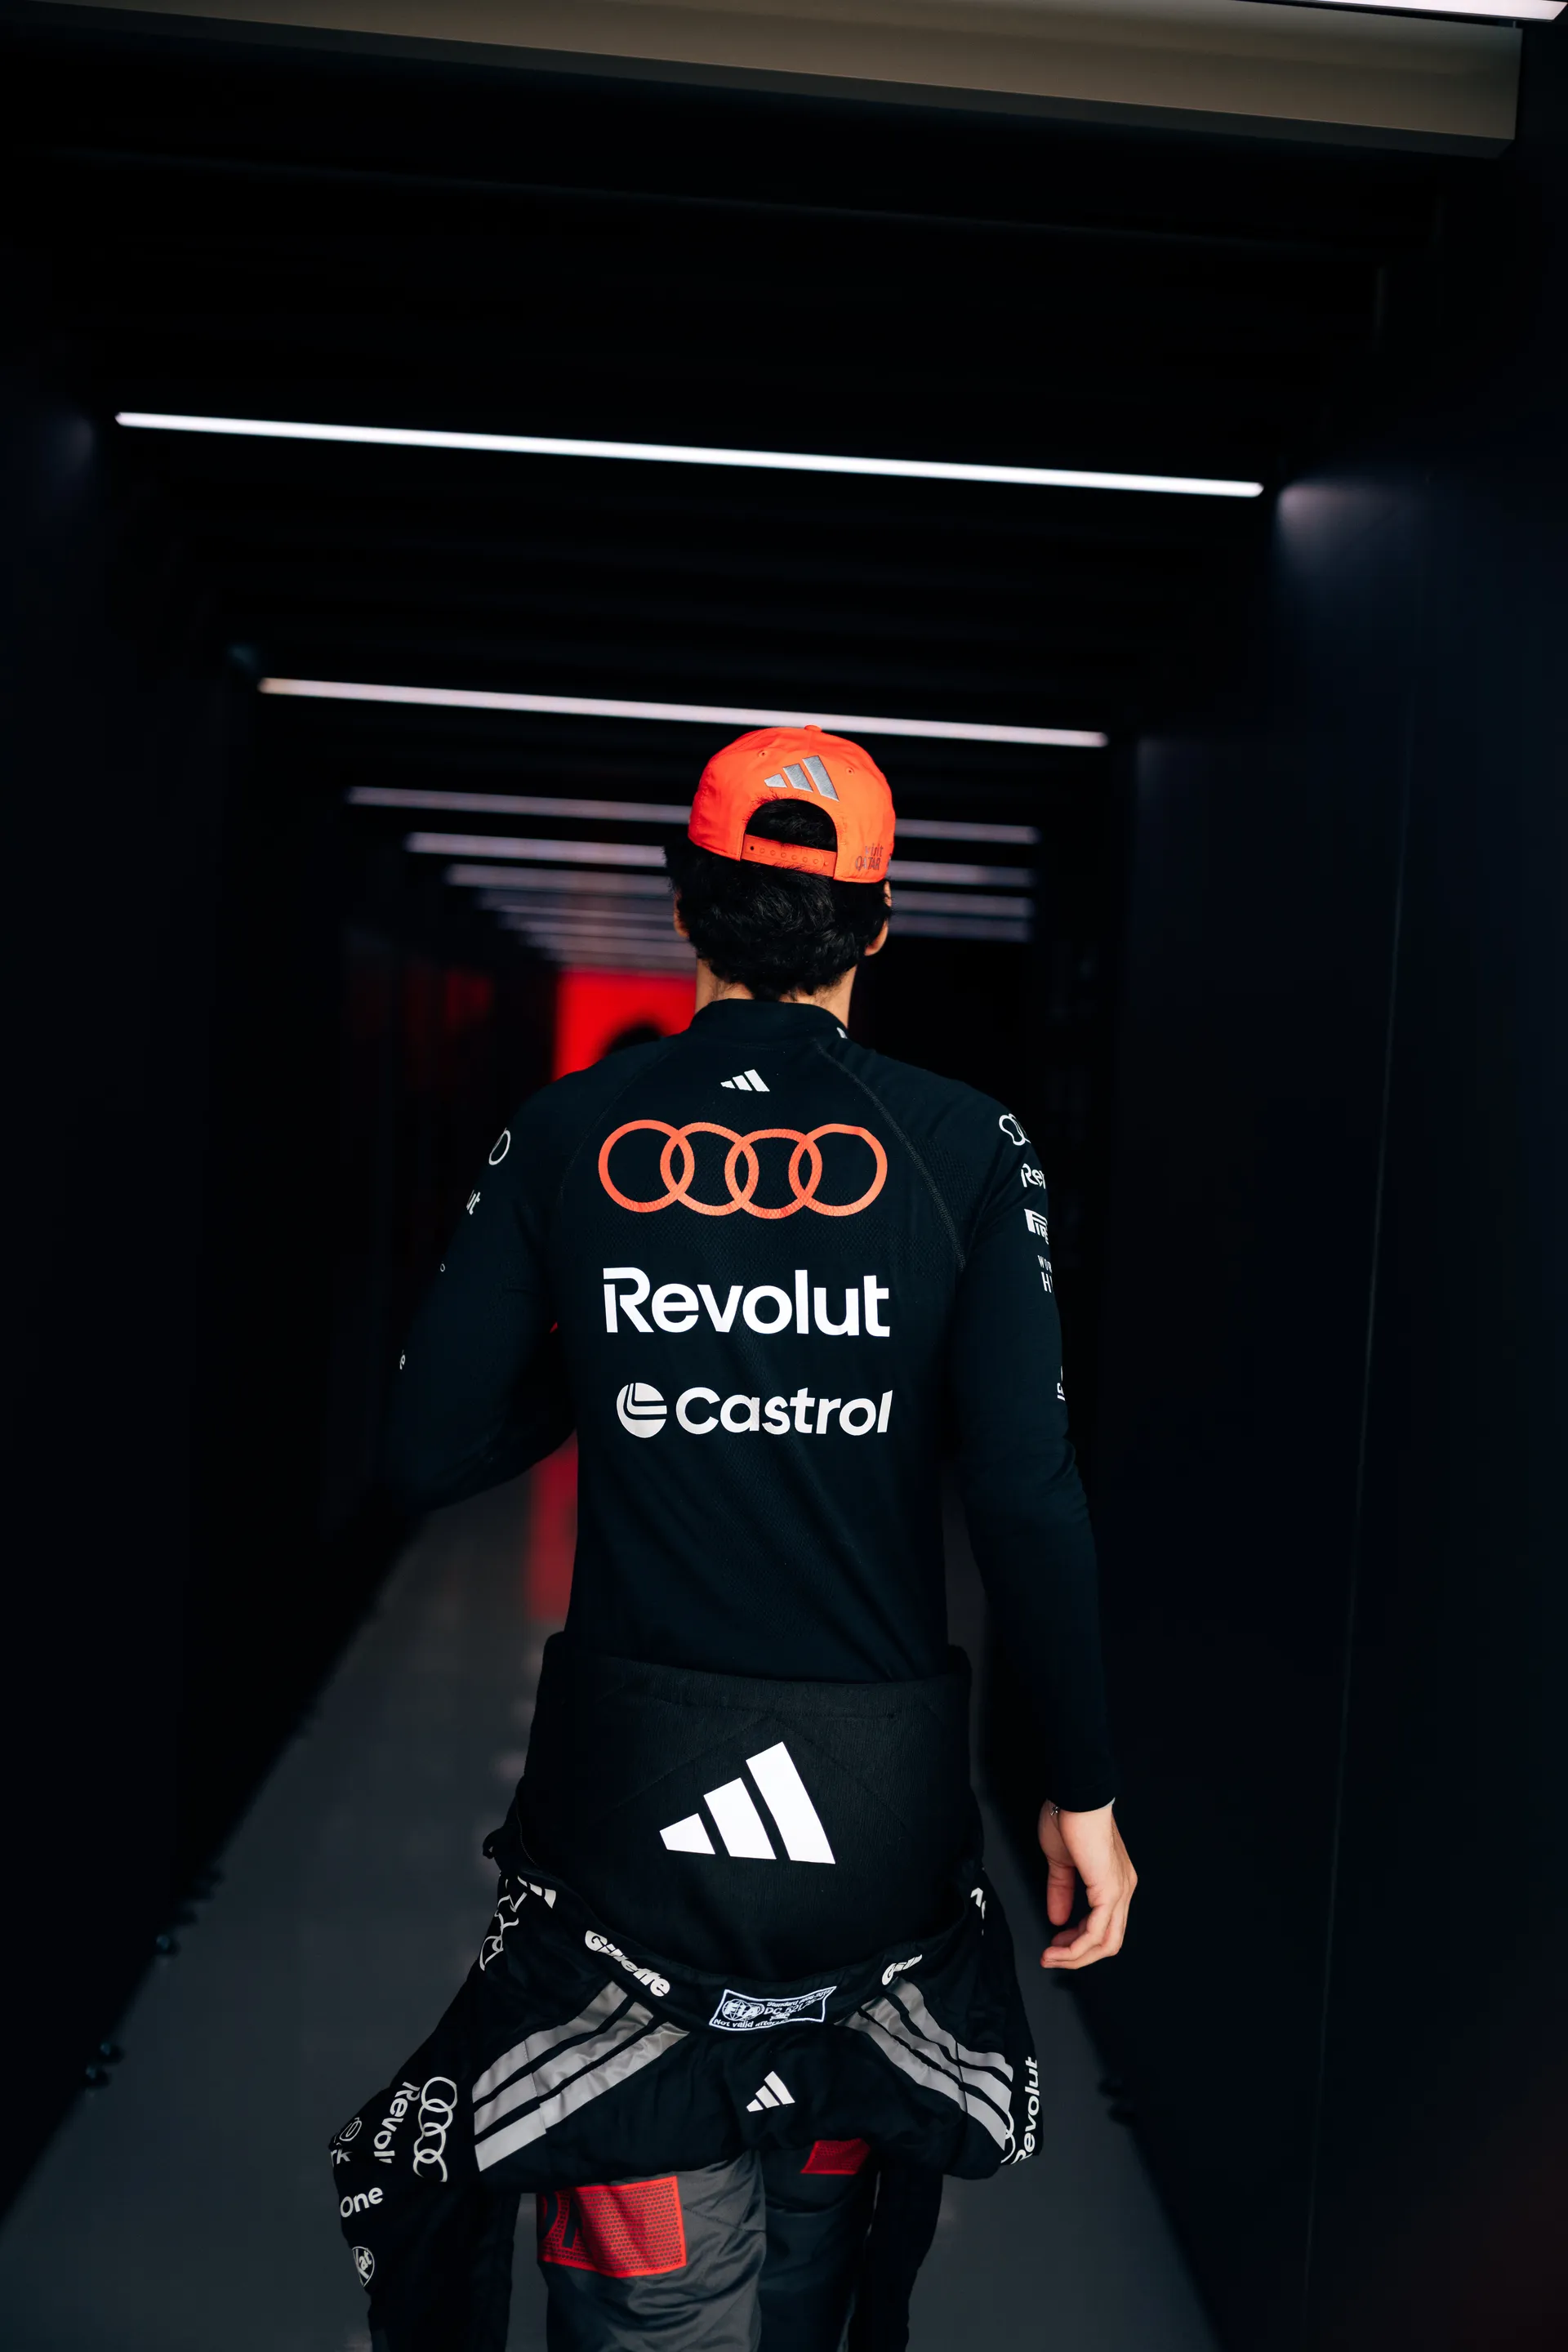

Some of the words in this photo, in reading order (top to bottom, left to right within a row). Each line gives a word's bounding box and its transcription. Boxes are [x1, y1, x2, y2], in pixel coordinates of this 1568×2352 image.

[855, 855, 881, 871] QATAR
[603, 1267, 891, 1337] Revolut
[675, 1387, 893, 1436] Castrol
[724, 2001, 760, 2019] FIA
[713, 2019, 730, 2027] Not
[733, 2020, 755, 2028] valid
